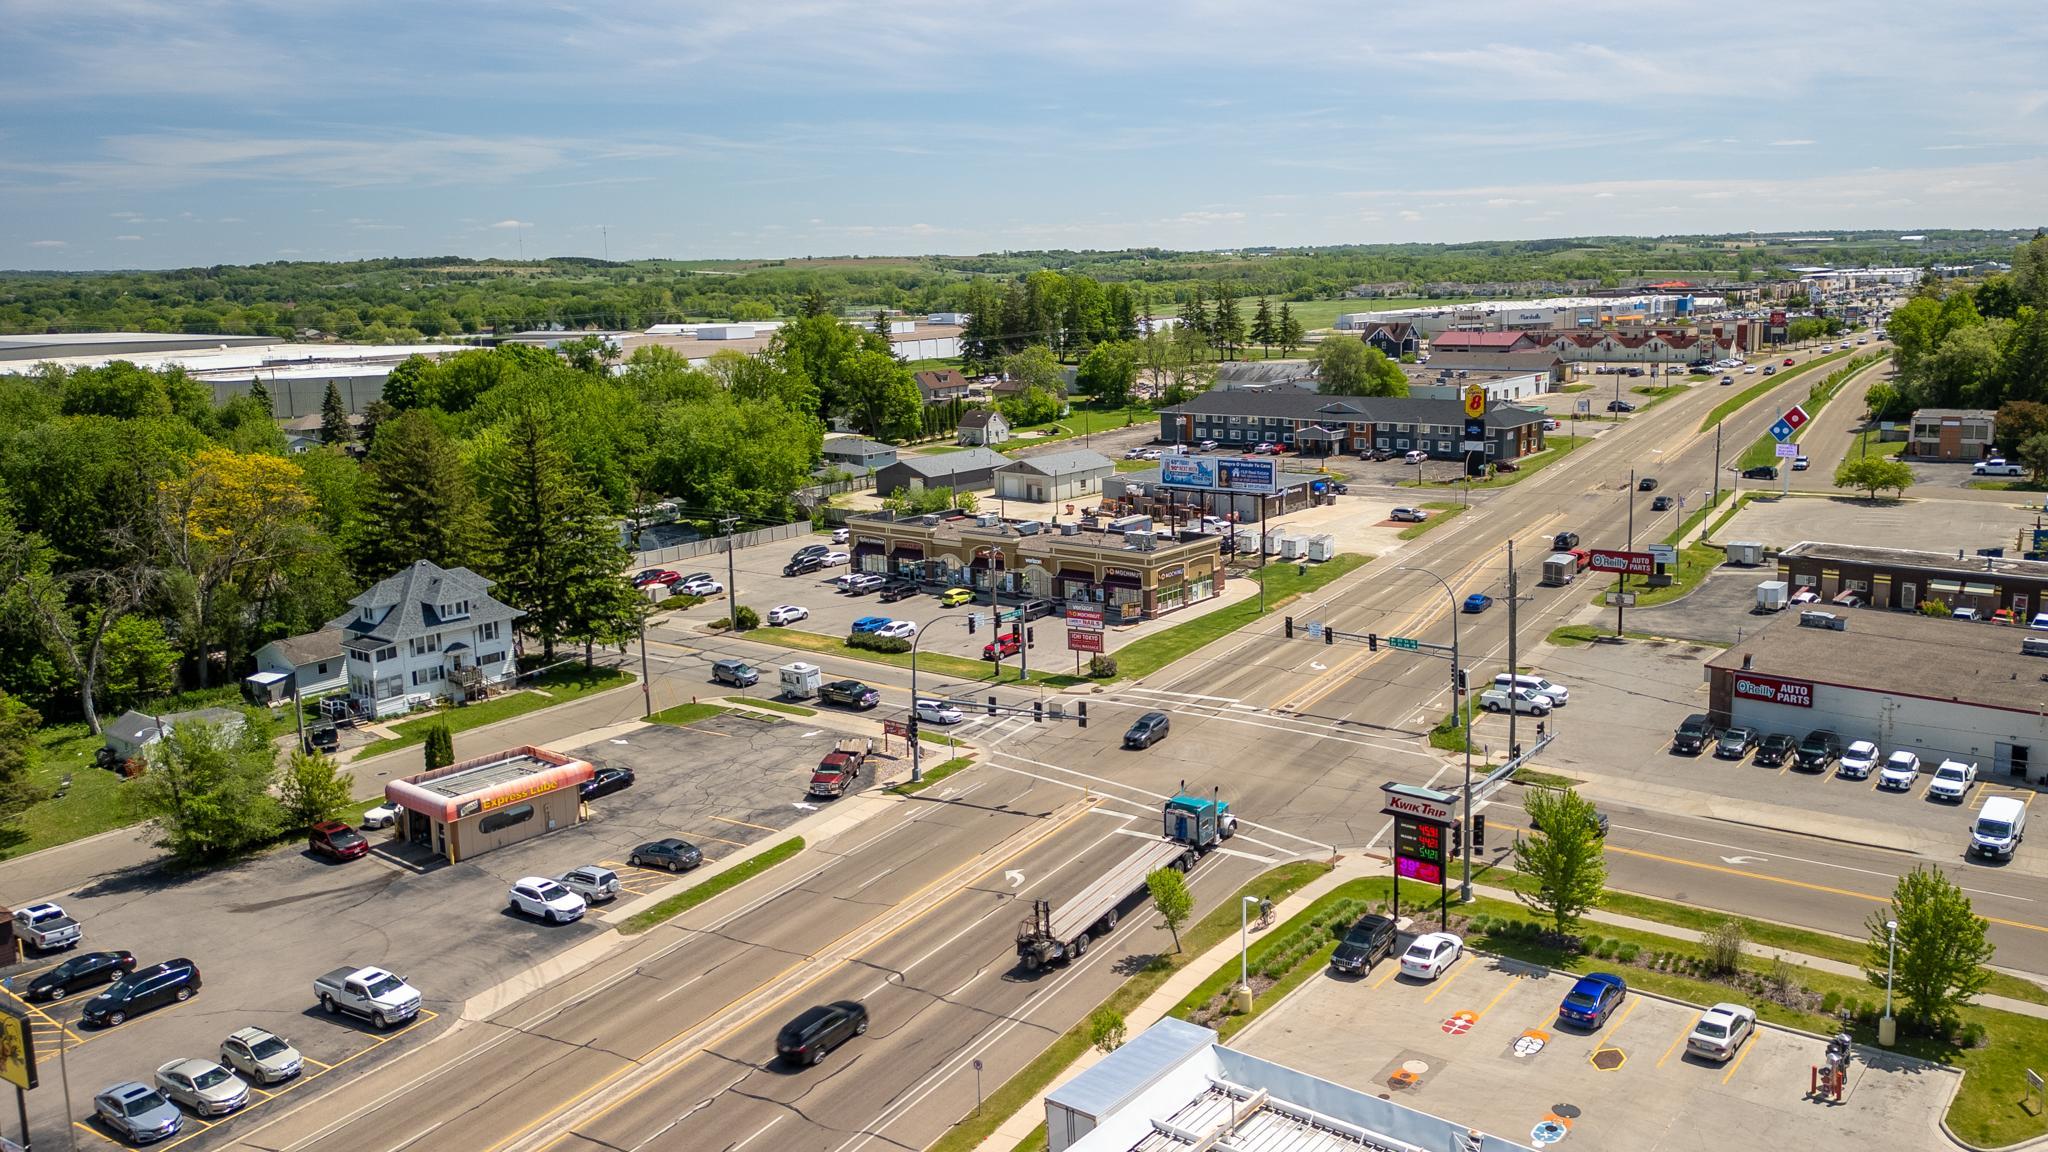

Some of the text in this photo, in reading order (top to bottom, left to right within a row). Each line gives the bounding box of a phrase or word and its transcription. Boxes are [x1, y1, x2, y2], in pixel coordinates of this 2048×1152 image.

[1470, 395, 1482, 410] 8
[1592, 554, 1629, 570] O'Reilly
[1114, 569, 1142, 578] MOCHINUT
[1737, 680, 1808, 698] O'Reilly AUTO
[1777, 692, 1810, 705] PARTS
[482, 790, 528, 809] Express
[530, 781, 557, 794] Lube
